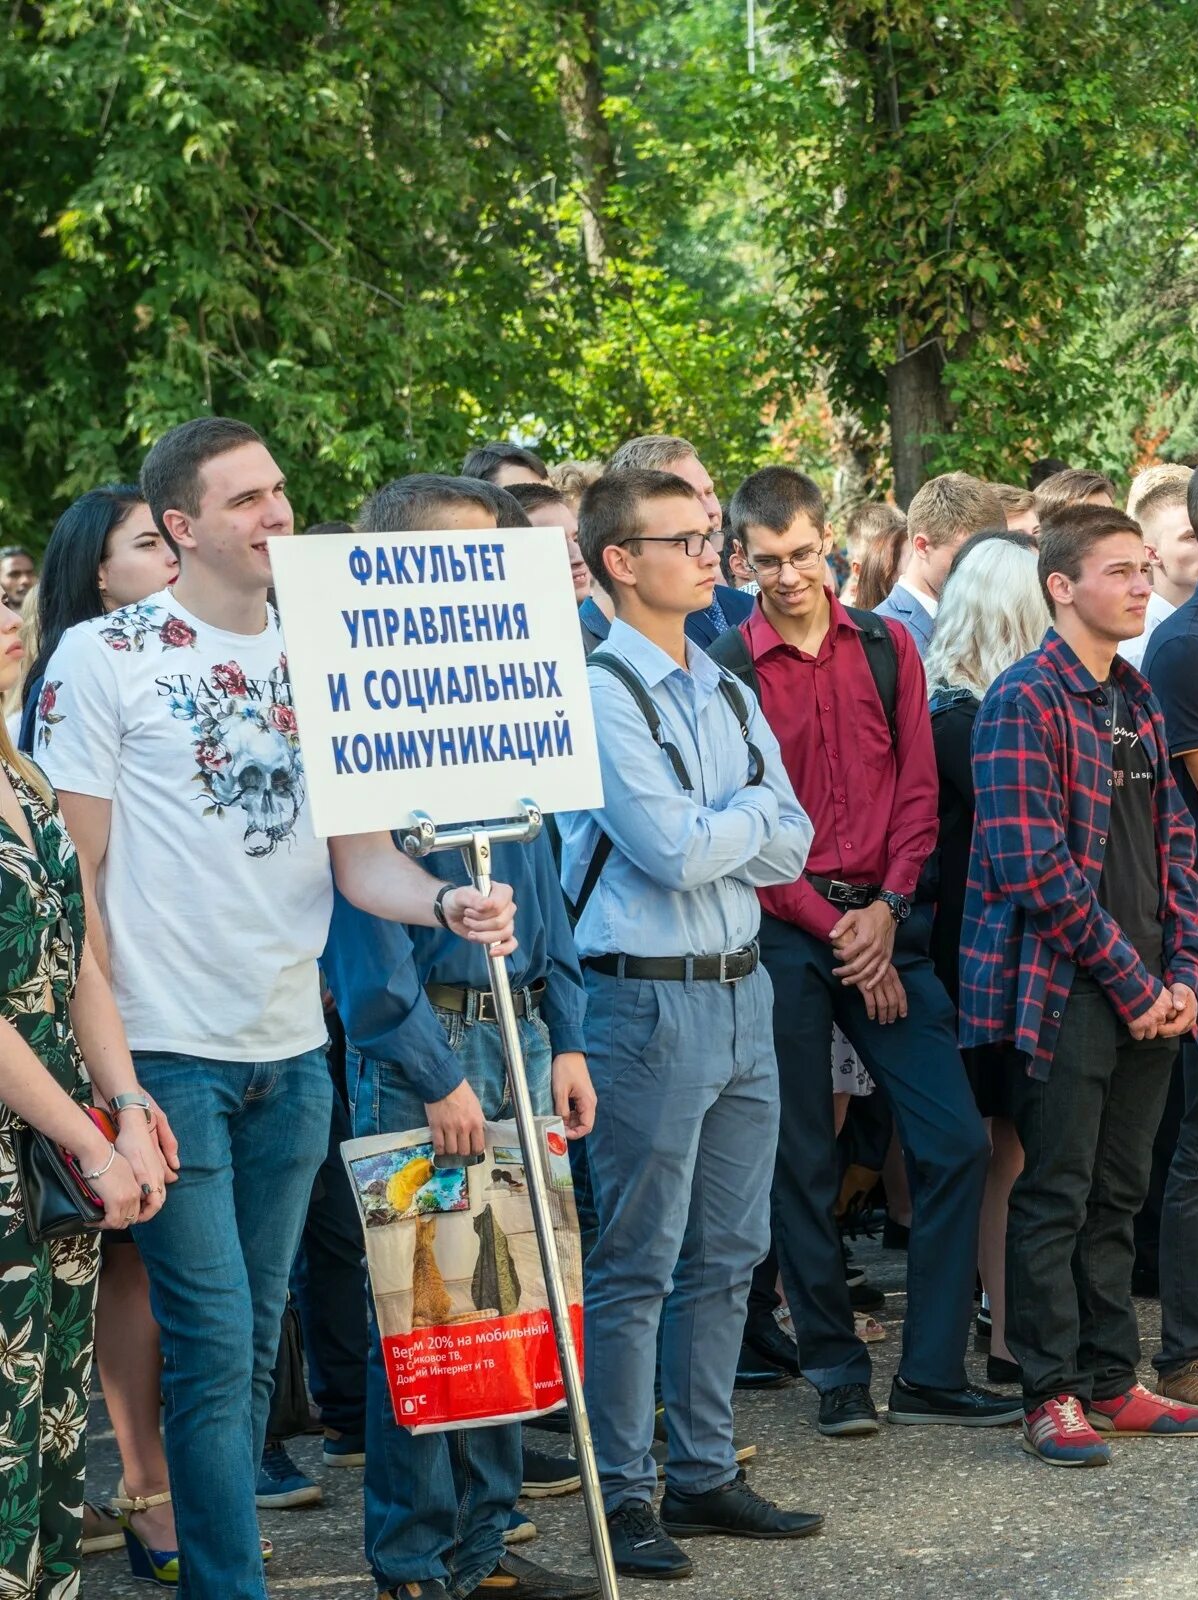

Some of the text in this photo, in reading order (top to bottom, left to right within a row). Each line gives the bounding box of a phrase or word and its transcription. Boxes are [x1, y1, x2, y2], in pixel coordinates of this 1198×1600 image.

[349, 543, 506, 585] ФАКУЛЬТЕТ
[341, 603, 530, 648] УПРАВЛЕНИЯ
[327, 661, 562, 713] И СОЦИАЛЬНЫХ
[331, 710, 573, 775] КОММУНИКАЦИЙ
[428, 1335, 454, 1350] 20%
[457, 1336, 472, 1347] на
[475, 1321, 549, 1344] мобильный
[395, 1363, 405, 1371] за
[430, 1364, 472, 1377] Интернет
[483, 1359, 495, 1368] ТВ
